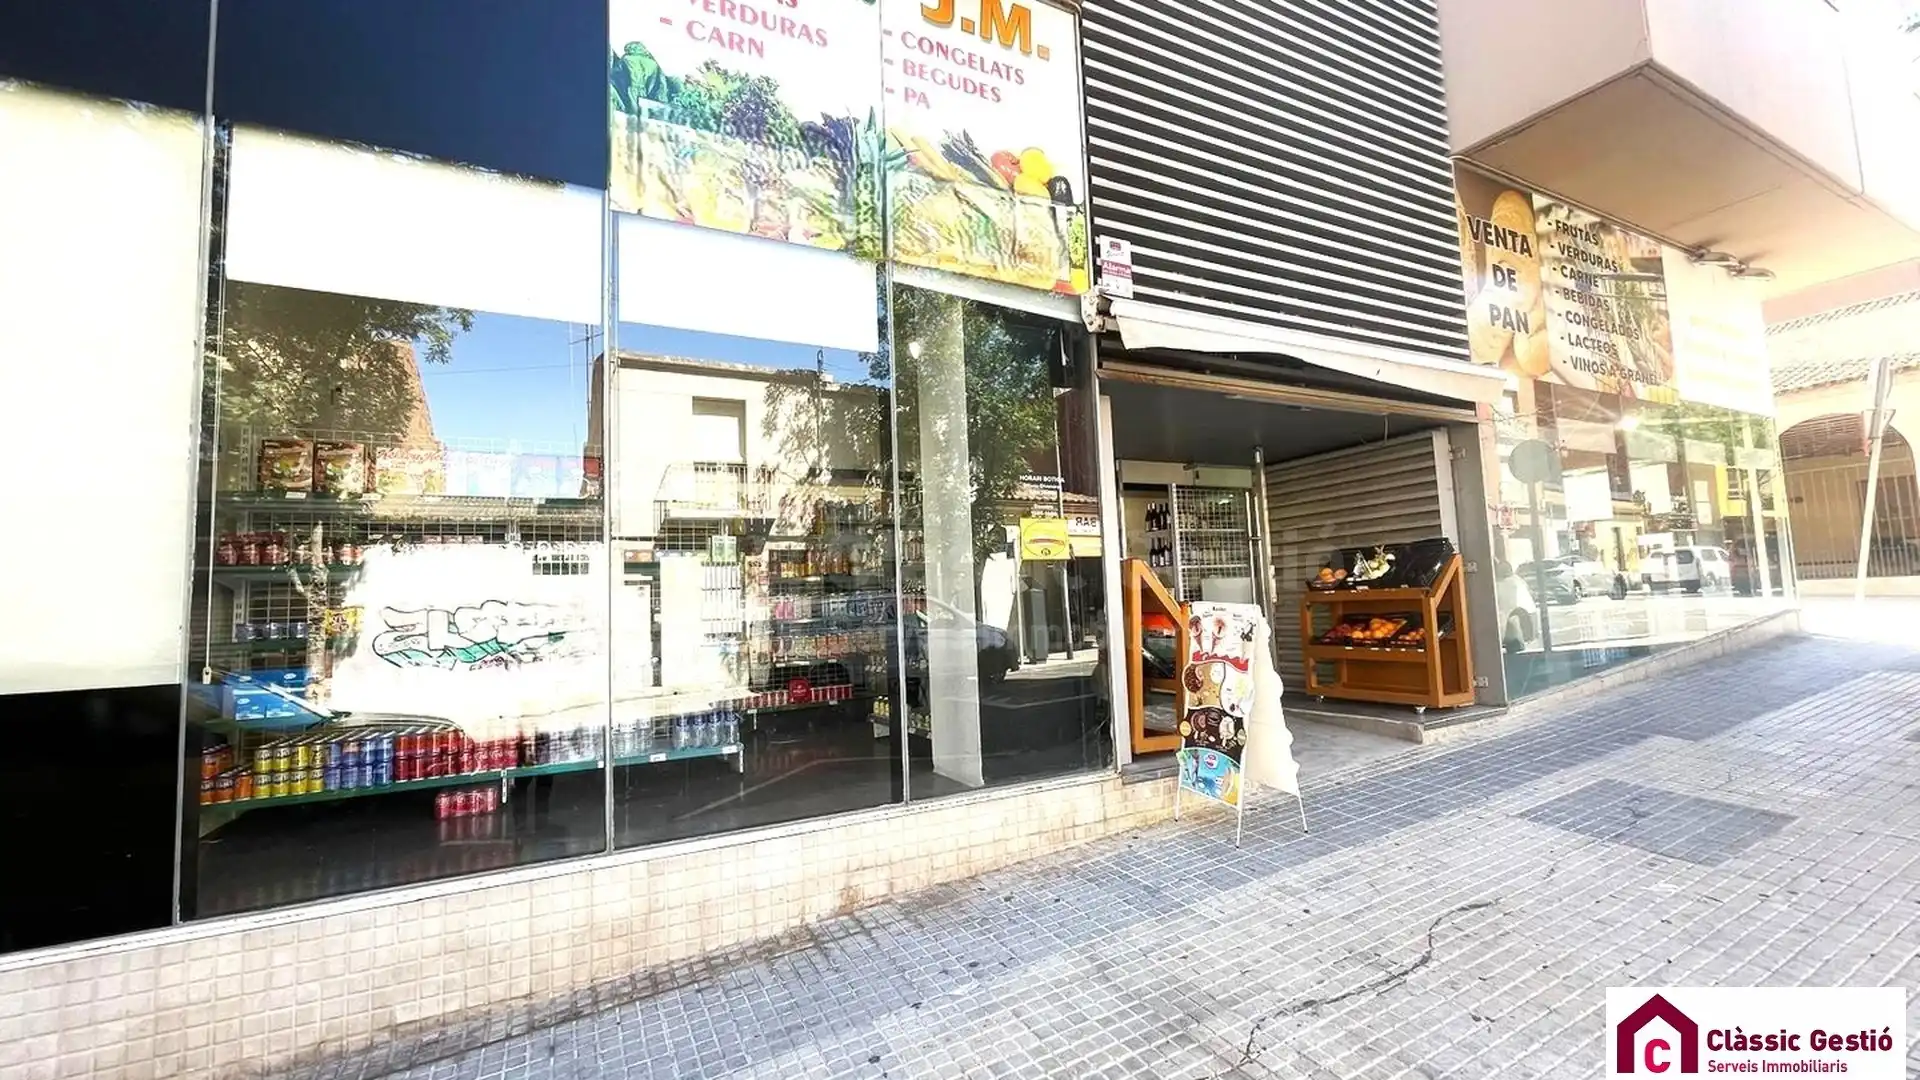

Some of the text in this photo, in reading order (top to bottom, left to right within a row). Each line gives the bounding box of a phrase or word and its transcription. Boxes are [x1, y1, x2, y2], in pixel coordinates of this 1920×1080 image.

[686, 20, 764, 59] CARN
[900, 31, 1025, 85] CONGELATS
[903, 58, 1002, 103] BEGUDES
[904, 87, 930, 109] PA
[1466, 215, 1533, 258] VENTA
[1555, 220, 1600, 246] FRUTAS
[1558, 242, 1618, 273] VERDURAS
[1492, 264, 1517, 292] DE
[1560, 265, 1600, 288] CARNE
[1563, 288, 1610, 311] BEBIDAS
[1489, 303, 1529, 334] PAN
[1565, 310, 1640, 340] CONGELADOS
[1568, 333, 1618, 355] LACTEOS
[1570, 356, 1606, 375] VINOS
